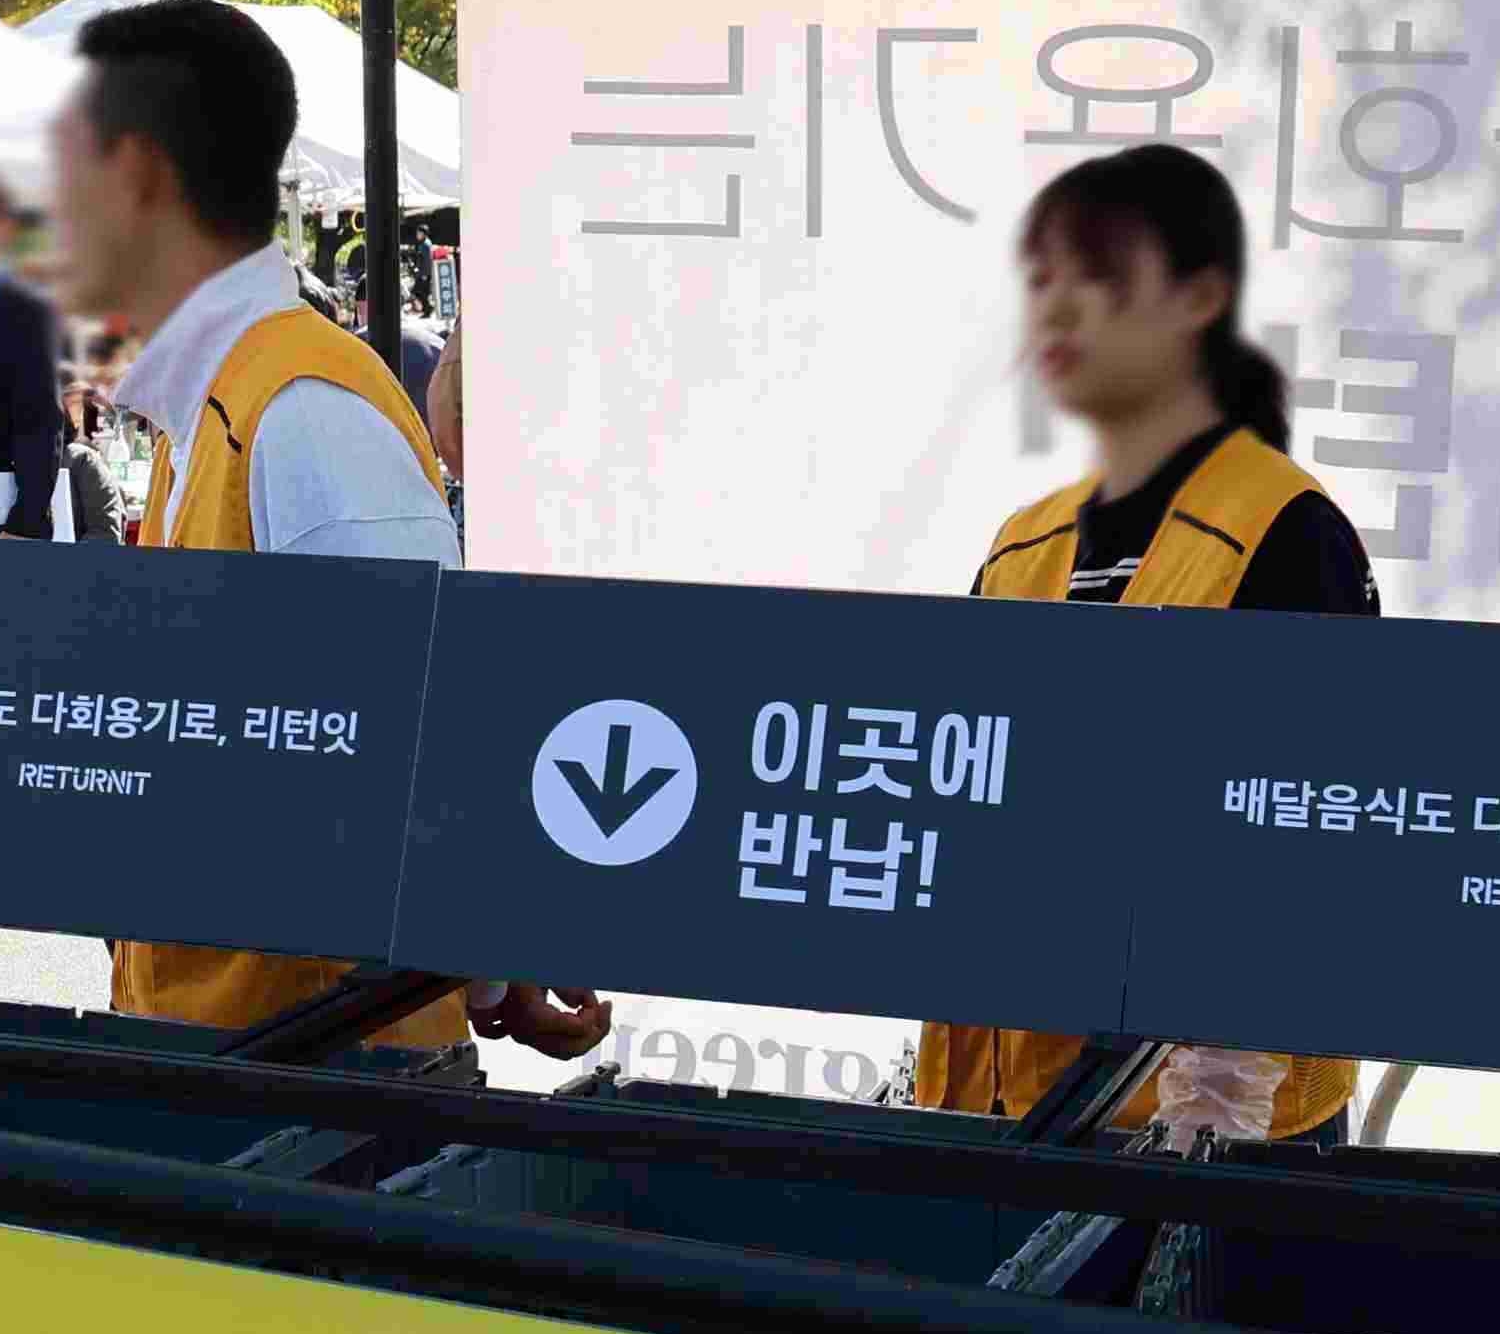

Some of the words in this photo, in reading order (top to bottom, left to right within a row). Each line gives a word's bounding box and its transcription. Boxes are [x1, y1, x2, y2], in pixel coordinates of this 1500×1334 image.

[31, 690, 229, 748] 다회용기로,
[243, 704, 360, 757] 리턴잇
[748, 700, 1013, 807] 이곳에
[1223, 776, 1456, 838] 배달음식도
[736, 812, 941, 912] 반납!
